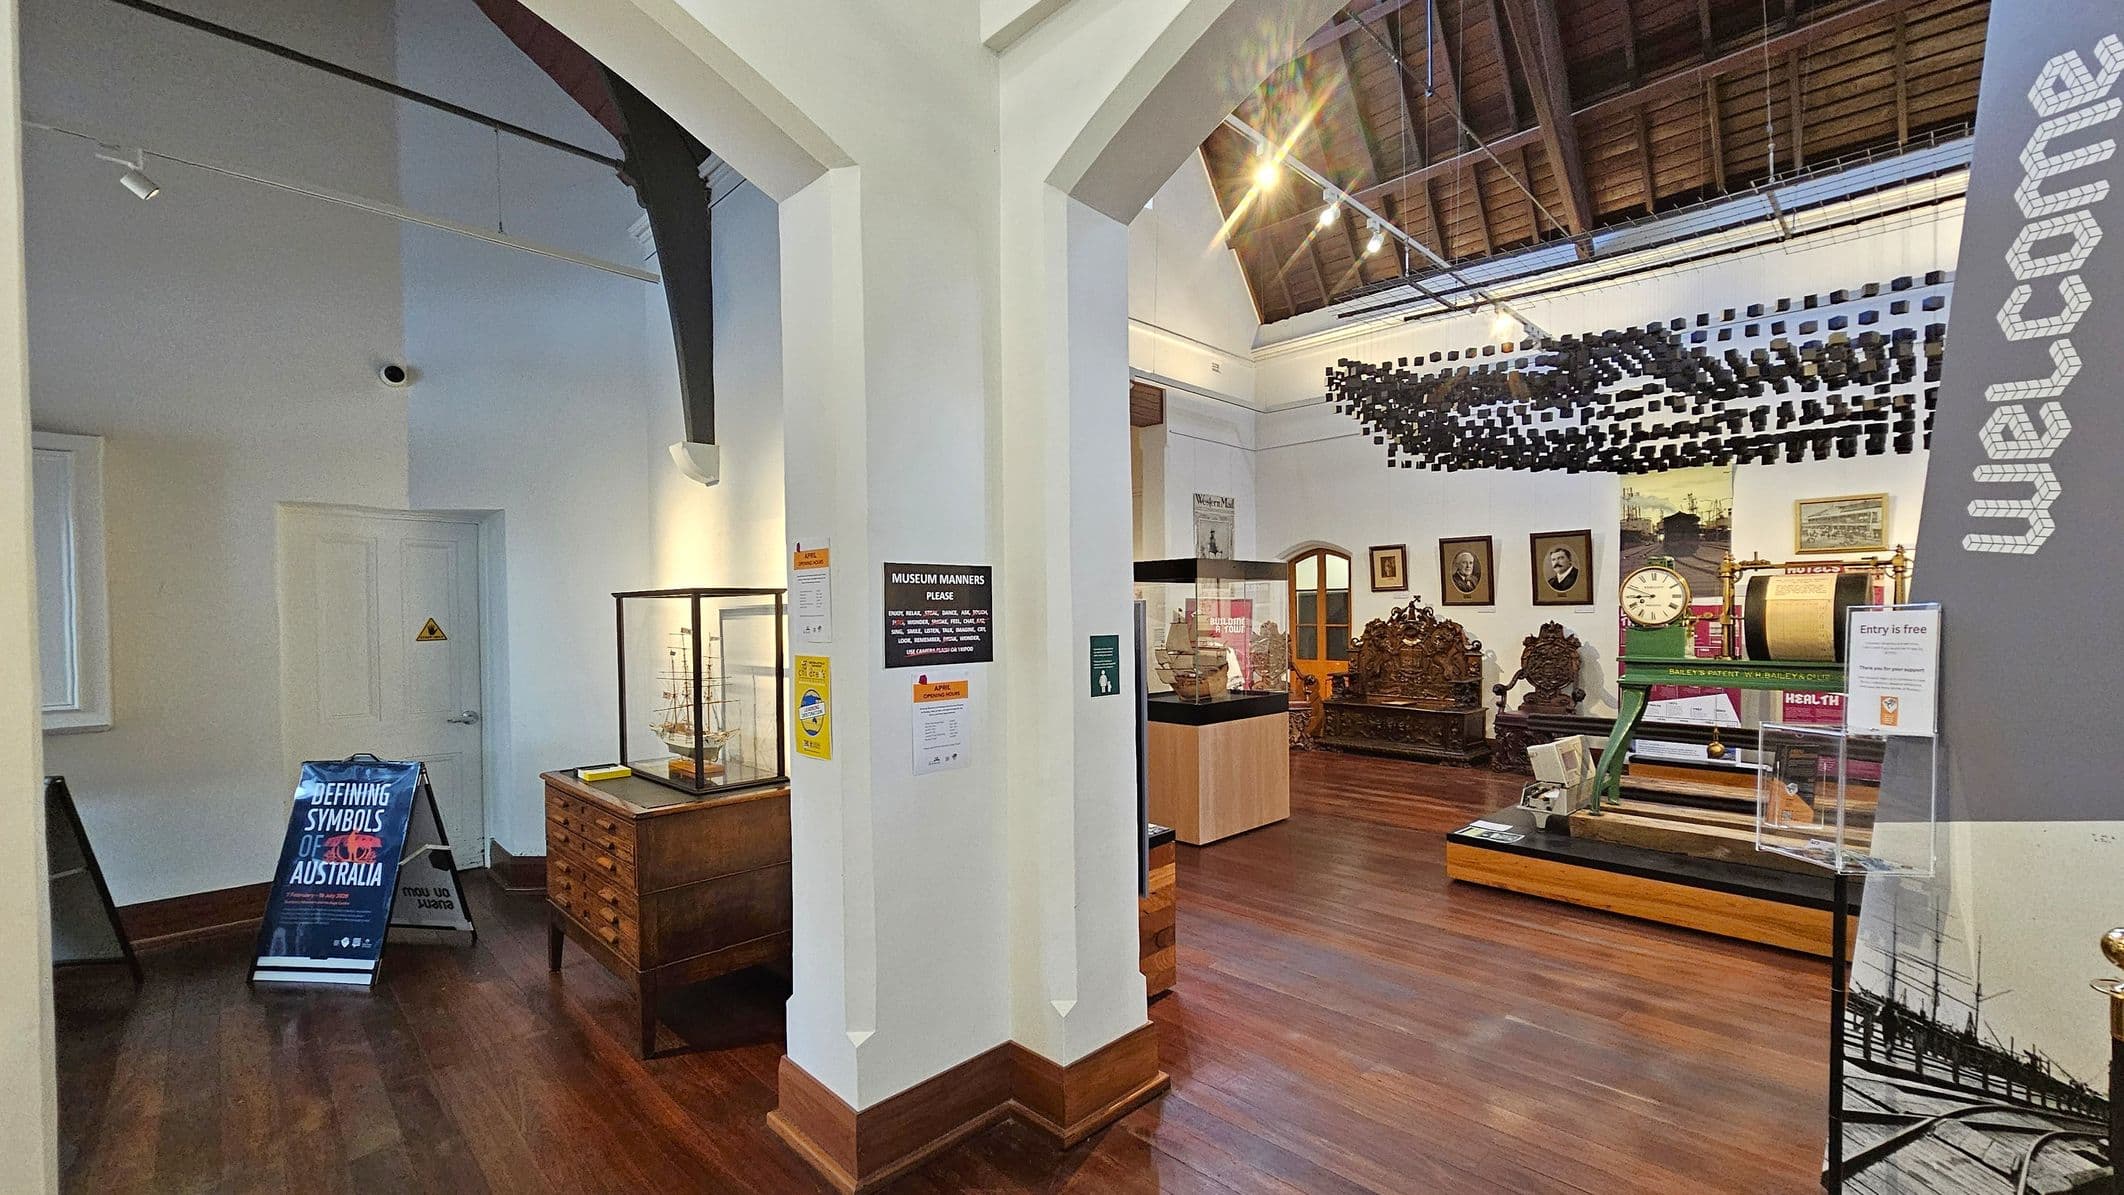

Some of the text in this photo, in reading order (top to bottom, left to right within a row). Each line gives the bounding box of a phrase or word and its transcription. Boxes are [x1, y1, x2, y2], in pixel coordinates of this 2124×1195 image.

[891, 573, 985, 585] MUSEUM MANNERS
[926, 591, 954, 600] PLEASE
[1860, 624, 1927, 636] Entry is free
[1669, 668, 1705, 676] BAILEY'S
[1707, 669, 1739, 677] PATENT
[1785, 692, 1839, 706] HEALTH
[311, 782, 392, 806] DEFINING
[304, 808, 385, 832] SYMBOLS
[299, 834, 325, 858] OF
[289, 860, 383, 887] AUSTRALIA
